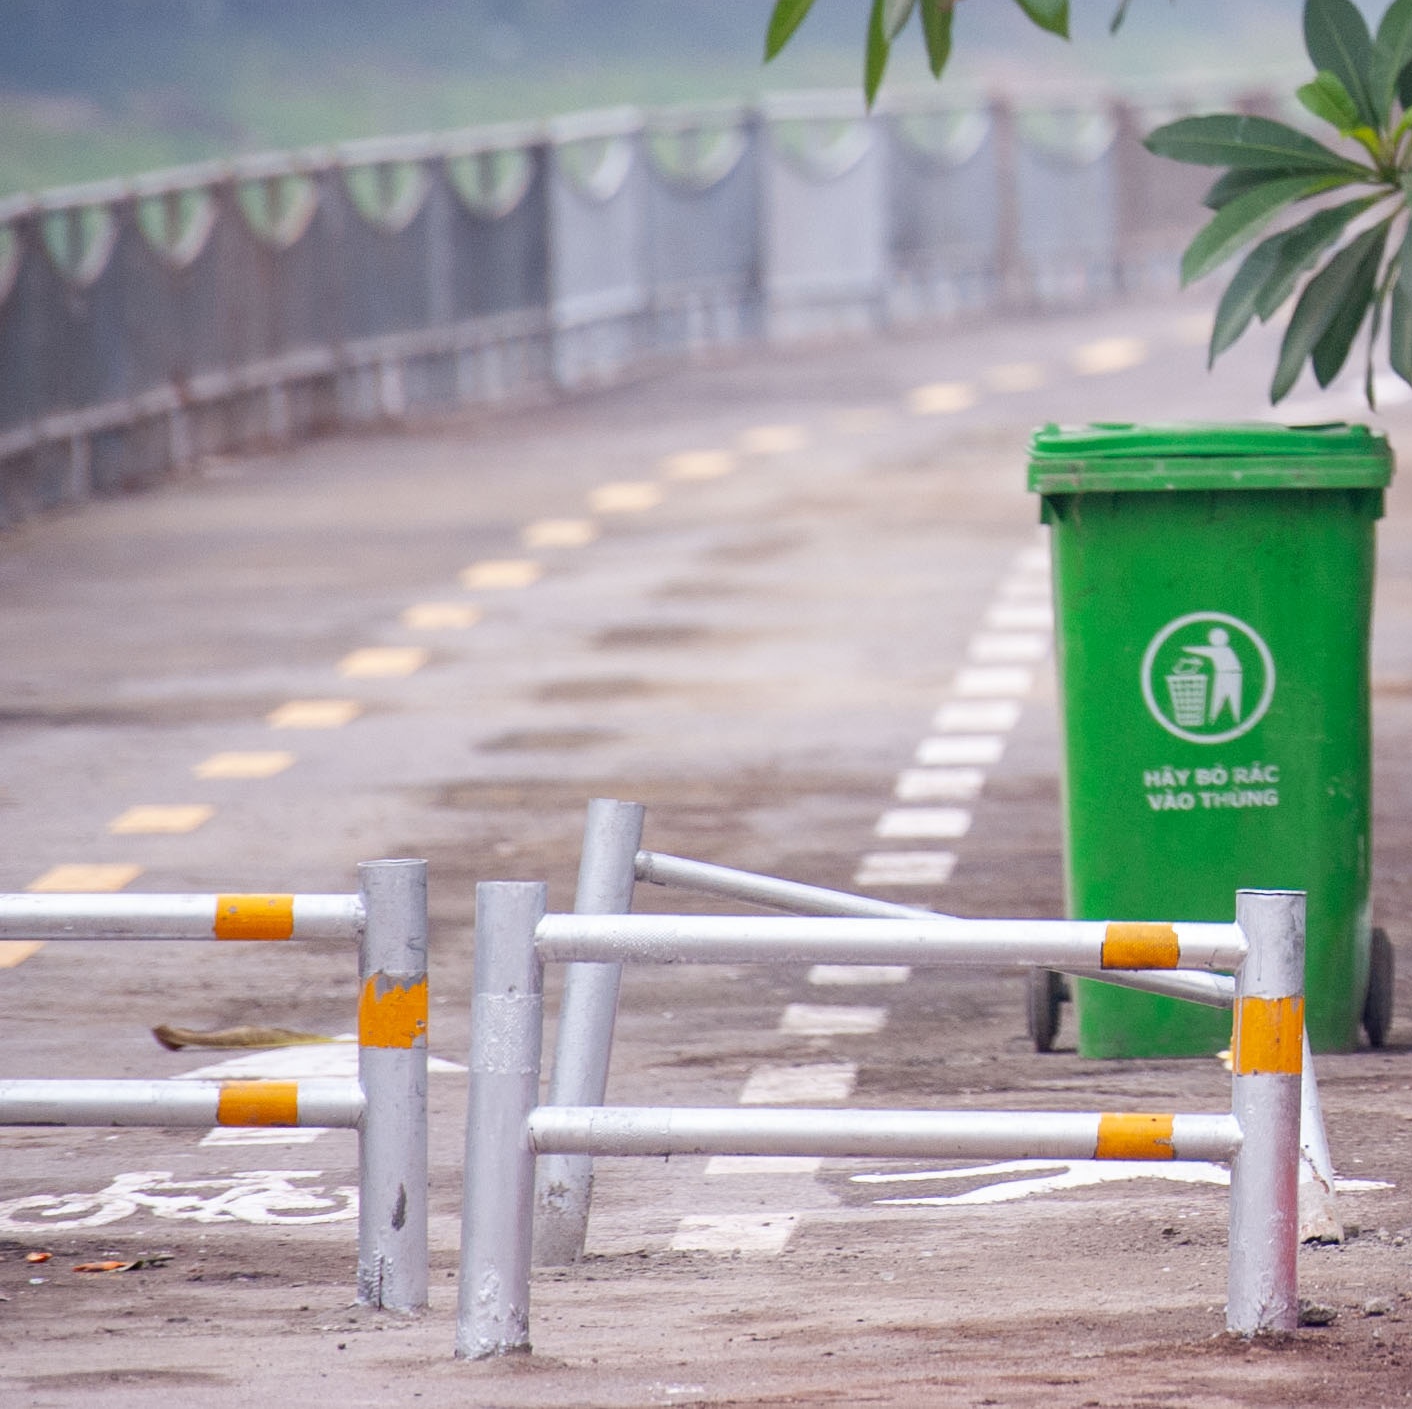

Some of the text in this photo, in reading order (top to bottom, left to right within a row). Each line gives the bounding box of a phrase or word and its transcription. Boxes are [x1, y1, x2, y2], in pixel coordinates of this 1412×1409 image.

[1232, 760, 1280, 784] RÁC
[1146, 786, 1279, 811] VÀO THÙNG
